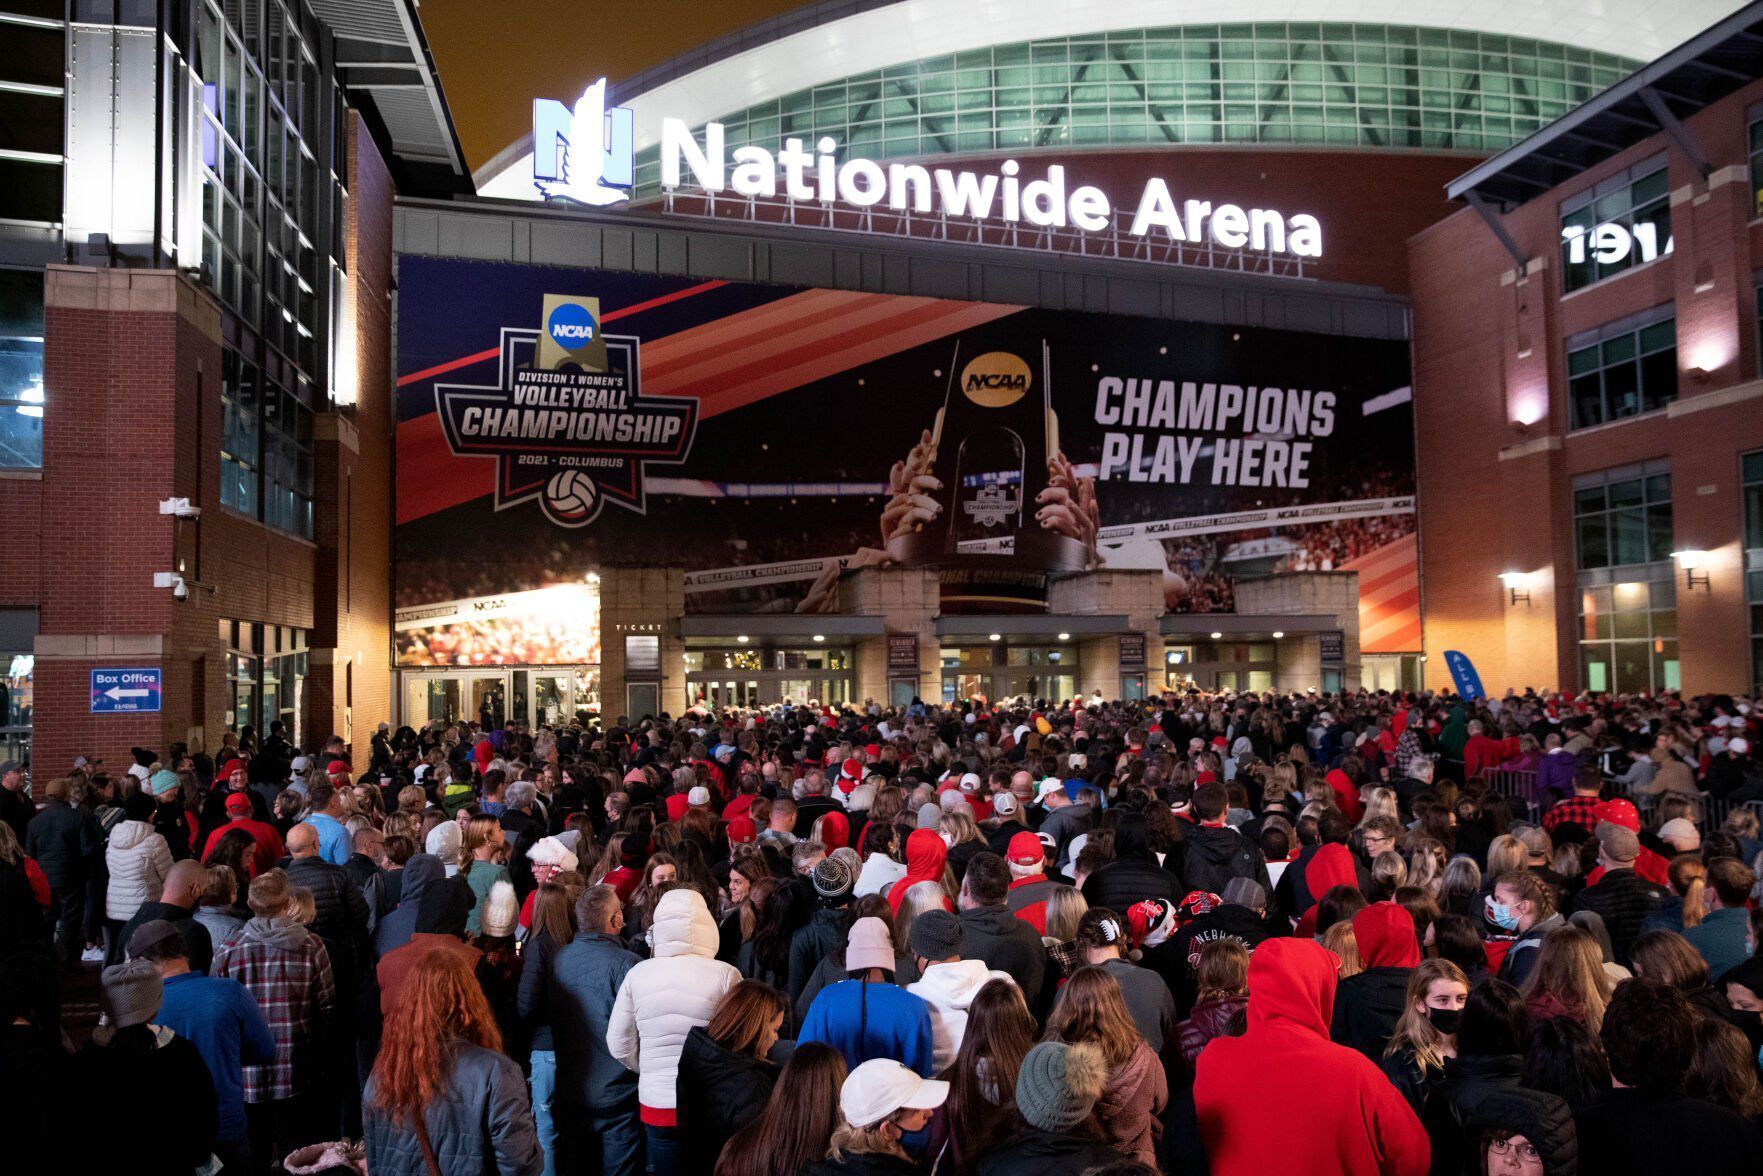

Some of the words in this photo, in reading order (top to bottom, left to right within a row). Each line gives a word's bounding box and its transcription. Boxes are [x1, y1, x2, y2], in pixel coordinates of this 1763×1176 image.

[661, 117, 1111, 232] Nationwide
[1130, 177, 1323, 257] Arena
[552, 324, 593, 339] NCAA
[518, 372, 568, 385] DIVISION
[578, 375, 624, 387] WOMEN'S
[966, 374, 1027, 392] NCAA
[513, 385, 628, 410] VOLLEYBALL
[1094, 376, 1337, 437] CHAMPIONS
[461, 407, 681, 444] CHAMPIONSHIP
[518, 455, 549, 466] 2021
[559, 456, 624, 468] COLUMBUS
[1099, 432, 1203, 484] PLAY
[1211, 437, 1314, 489] HERE
[1145, 523, 1170, 534] NCAA
[1277, 509, 1299, 519] NCAA
[698, 570, 753, 585] VOLLEYBALL
[755, 561, 823, 578] CHAMPIONSHIP
[474, 599, 505, 611] NCAA
[96, 674, 118, 683] Box
[121, 673, 156, 683] Office
[1453, 654, 1470, 682] ALL
